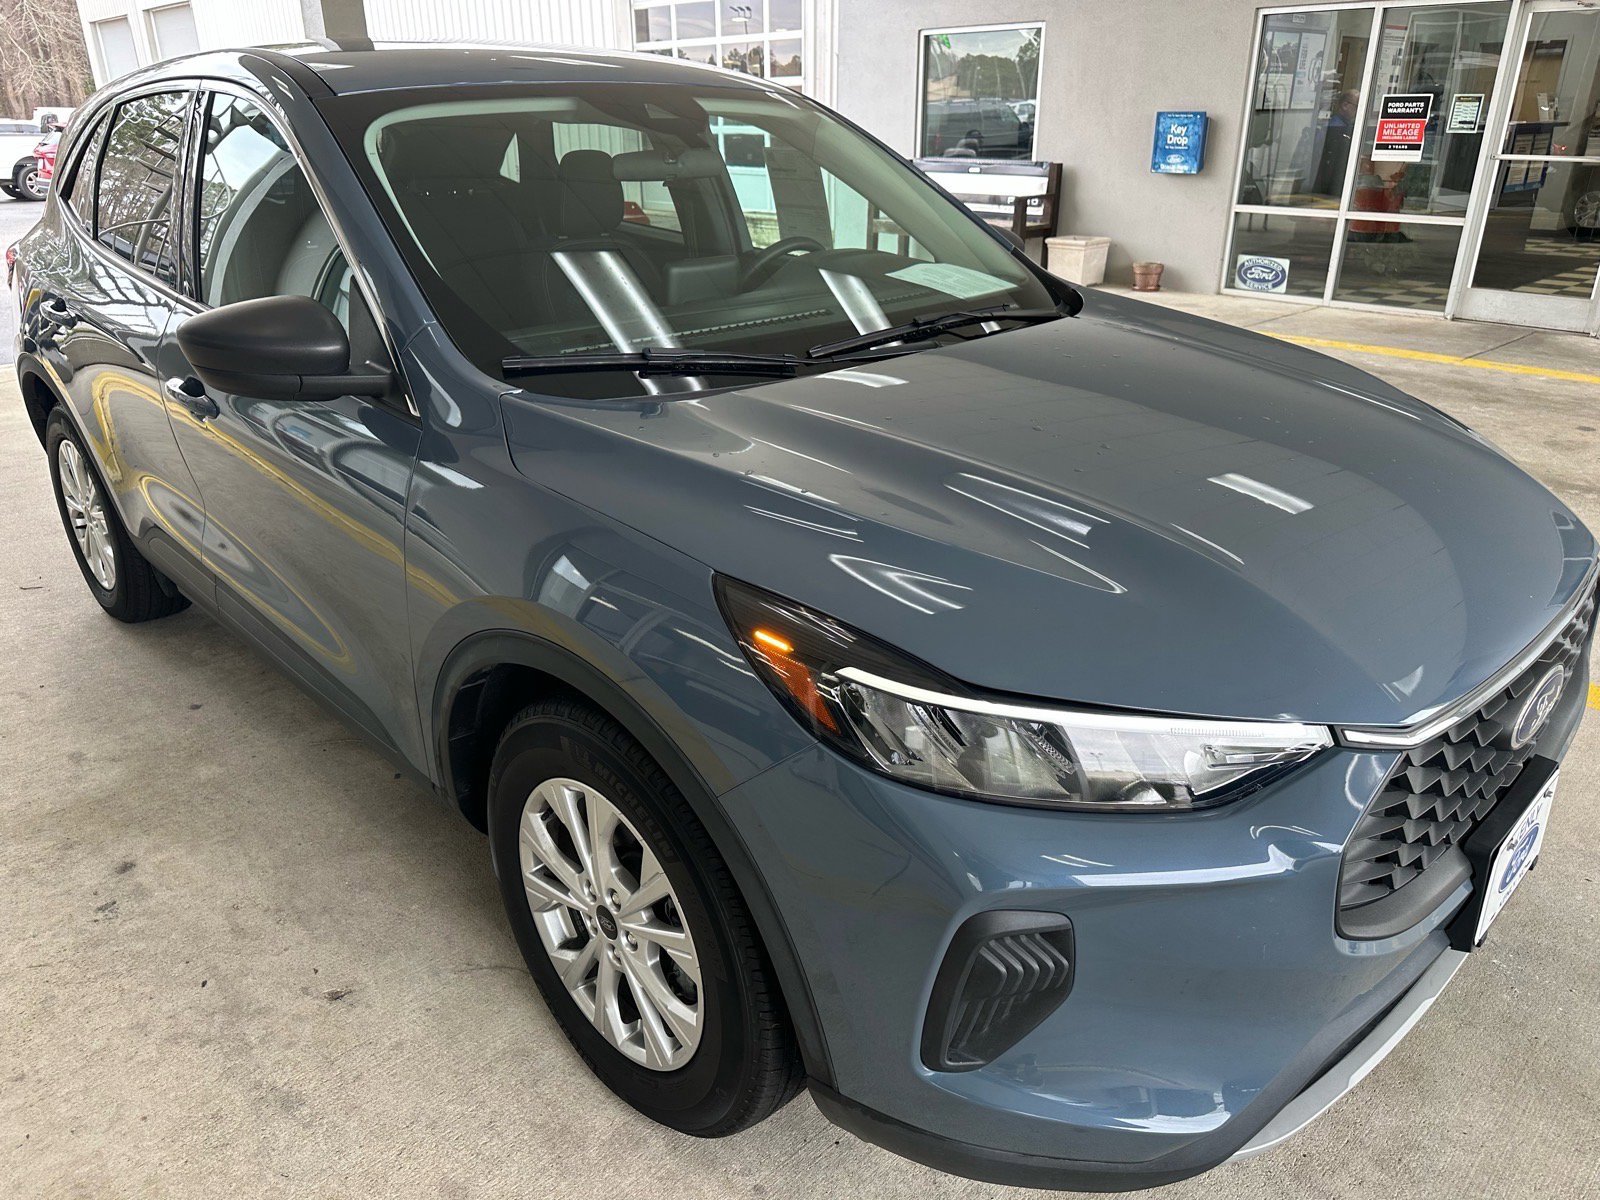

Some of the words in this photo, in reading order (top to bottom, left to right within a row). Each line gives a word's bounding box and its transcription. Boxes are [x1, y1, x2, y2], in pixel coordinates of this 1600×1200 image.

[1171, 124, 1187, 136] Key
[1167, 134, 1188, 146] Drop
[1244, 258, 1283, 271] AUTHORIZED
[1246, 266, 1276, 281] Ford
[1246, 280, 1273, 290] SERVICE
